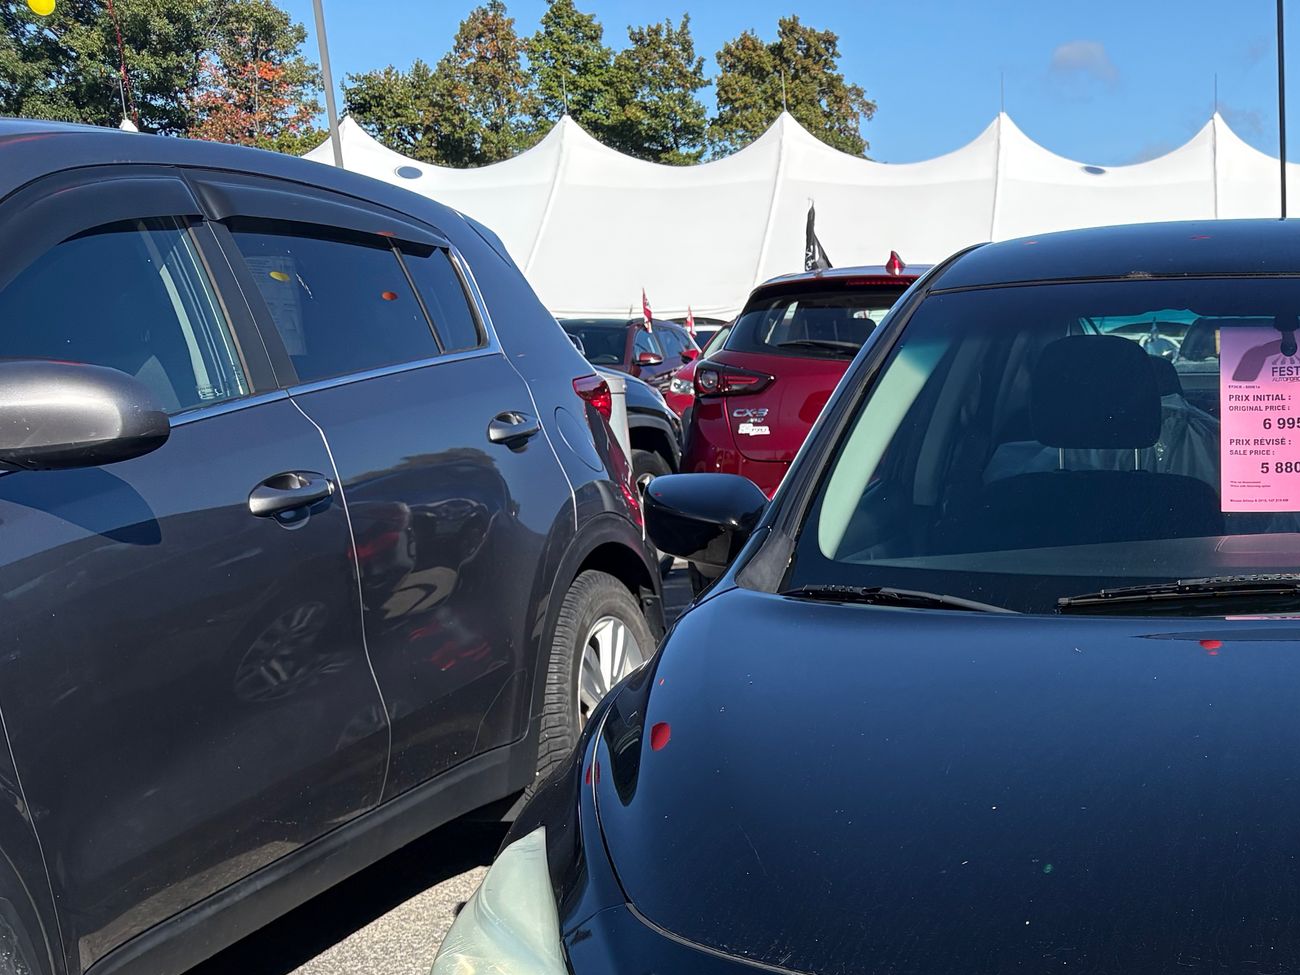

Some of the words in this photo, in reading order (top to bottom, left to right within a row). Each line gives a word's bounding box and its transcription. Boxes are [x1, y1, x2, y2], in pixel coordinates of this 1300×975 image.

[1228, 394, 1250, 402] PRIX
[1262, 418, 1272, 430] 6
[1229, 438, 1251, 446] PRIX
[1260, 462, 1270, 474] 5
